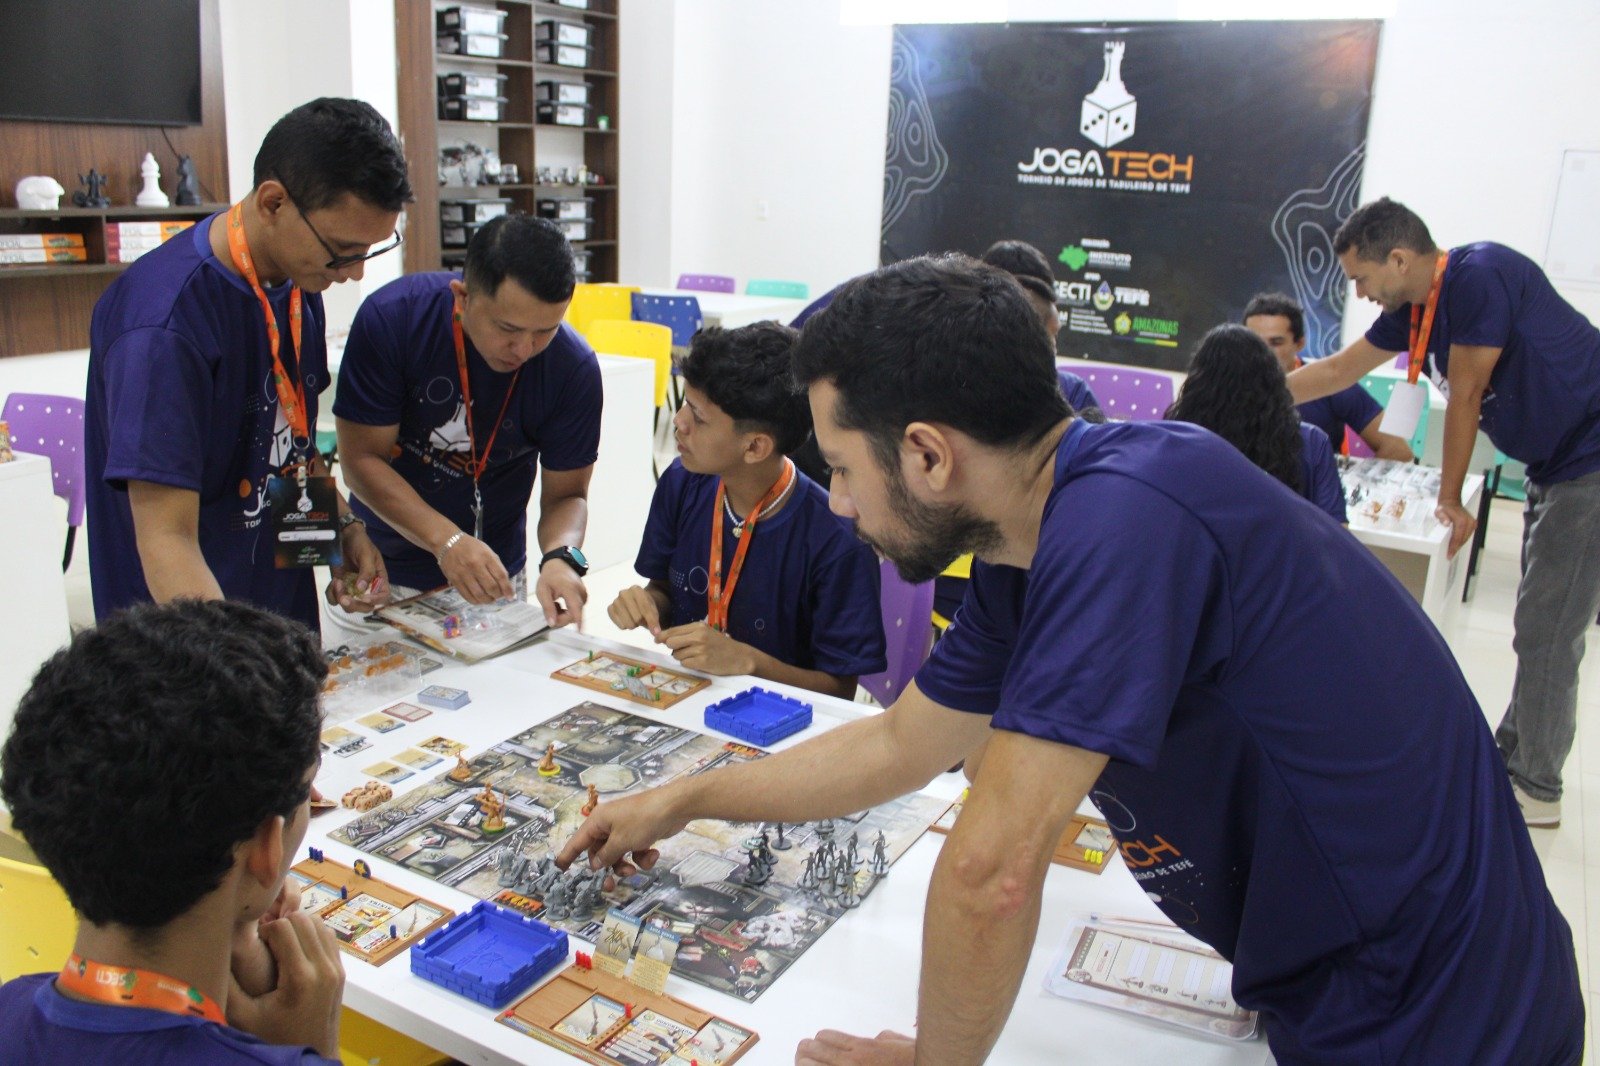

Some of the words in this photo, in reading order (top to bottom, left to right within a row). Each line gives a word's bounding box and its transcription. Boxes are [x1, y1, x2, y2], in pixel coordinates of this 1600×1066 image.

[1018, 173, 1053, 185] TORNEIO
[1054, 175, 1066, 186] DE
[1067, 176, 1094, 188] JOGOS
[1095, 178, 1107, 189] DE
[1108, 179, 1154, 192] TABULEIRO
[1155, 181, 1168, 192] DE
[1132, 316, 1179, 336] AMAZONAS
